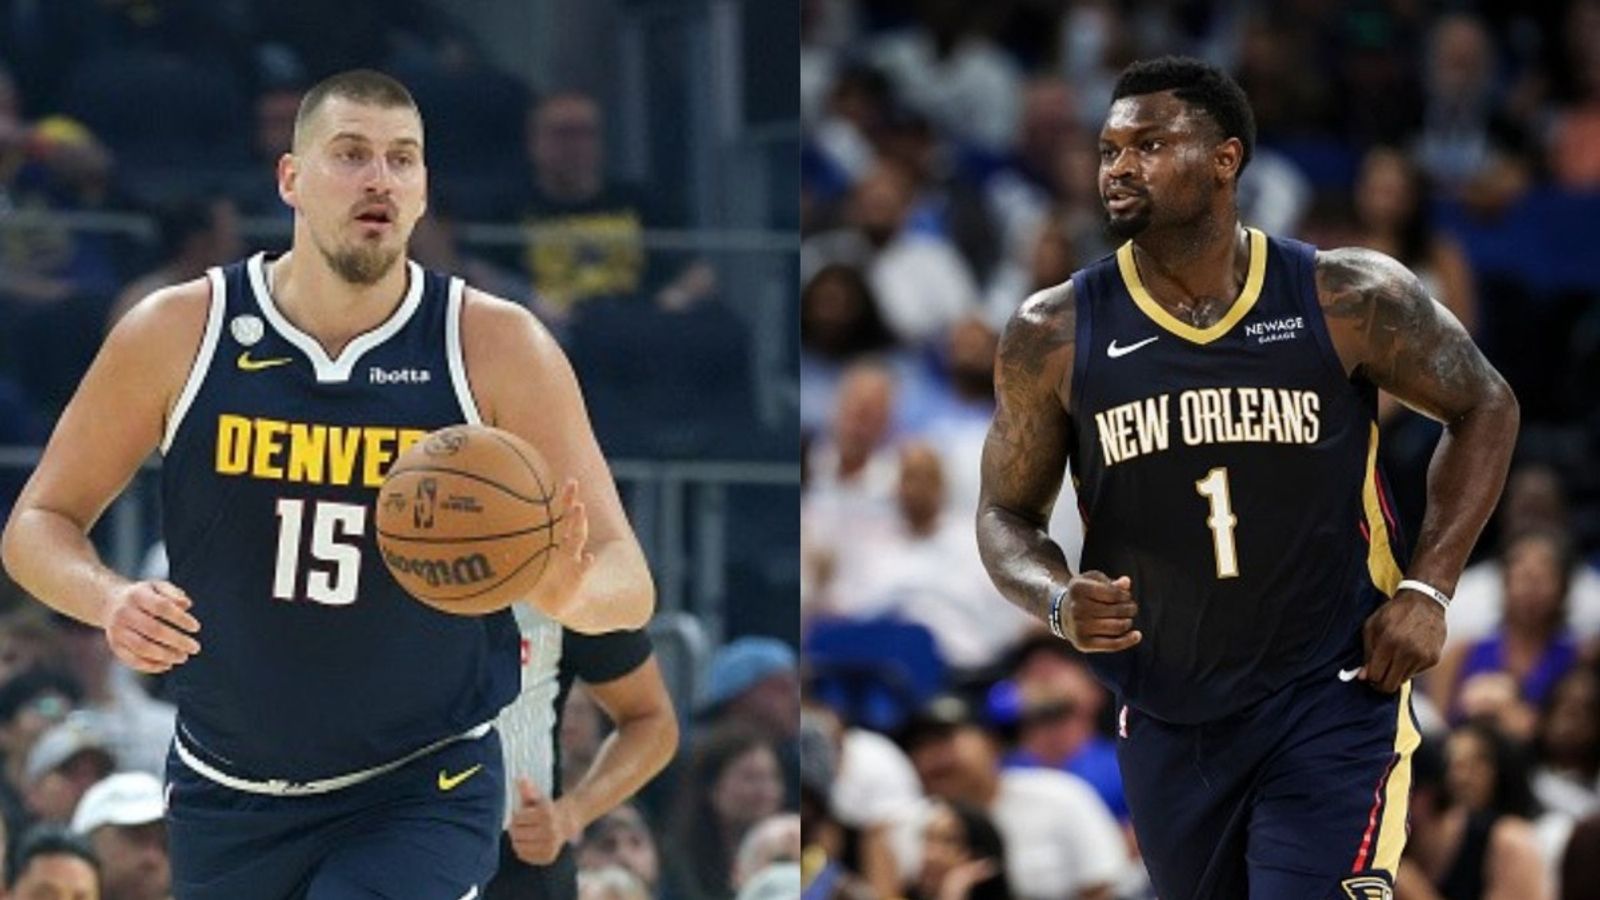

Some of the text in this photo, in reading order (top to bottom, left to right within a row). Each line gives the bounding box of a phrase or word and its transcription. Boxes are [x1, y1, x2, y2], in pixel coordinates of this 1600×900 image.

[1245, 317, 1304, 336] NEWAGE
[1259, 331, 1296, 344] GARAGE
[369, 366, 431, 384] ibotta
[1095, 387, 1320, 466] NEW ORLEANS
[1195, 466, 1240, 579] 1
[272, 498, 367, 606] 15
